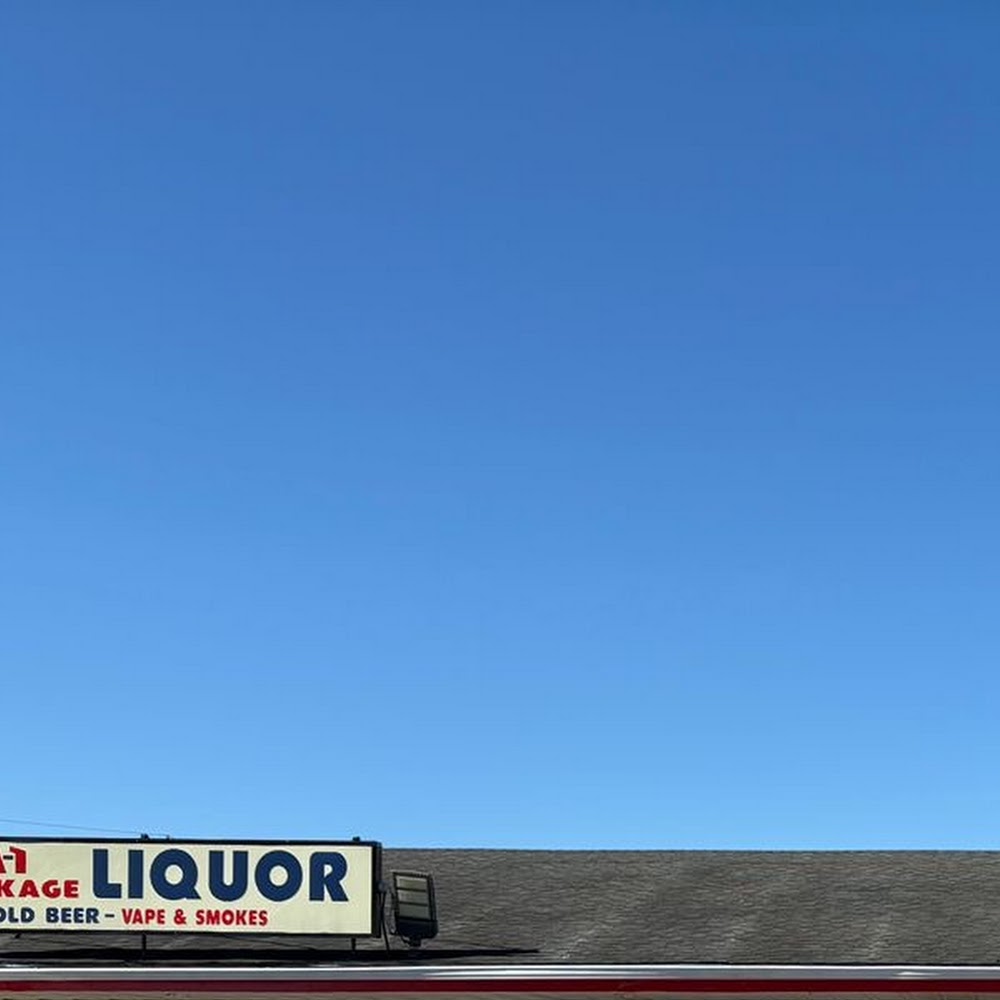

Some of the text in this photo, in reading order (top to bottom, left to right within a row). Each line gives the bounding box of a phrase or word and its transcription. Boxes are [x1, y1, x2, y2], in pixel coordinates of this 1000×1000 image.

[92, 848, 348, 901] LIQUOR
[46, 907, 99, 924] BEER
[122, 908, 165, 926] VAPE
[174, 909, 187, 926] &
[196, 909, 269, 927] SMOKES
